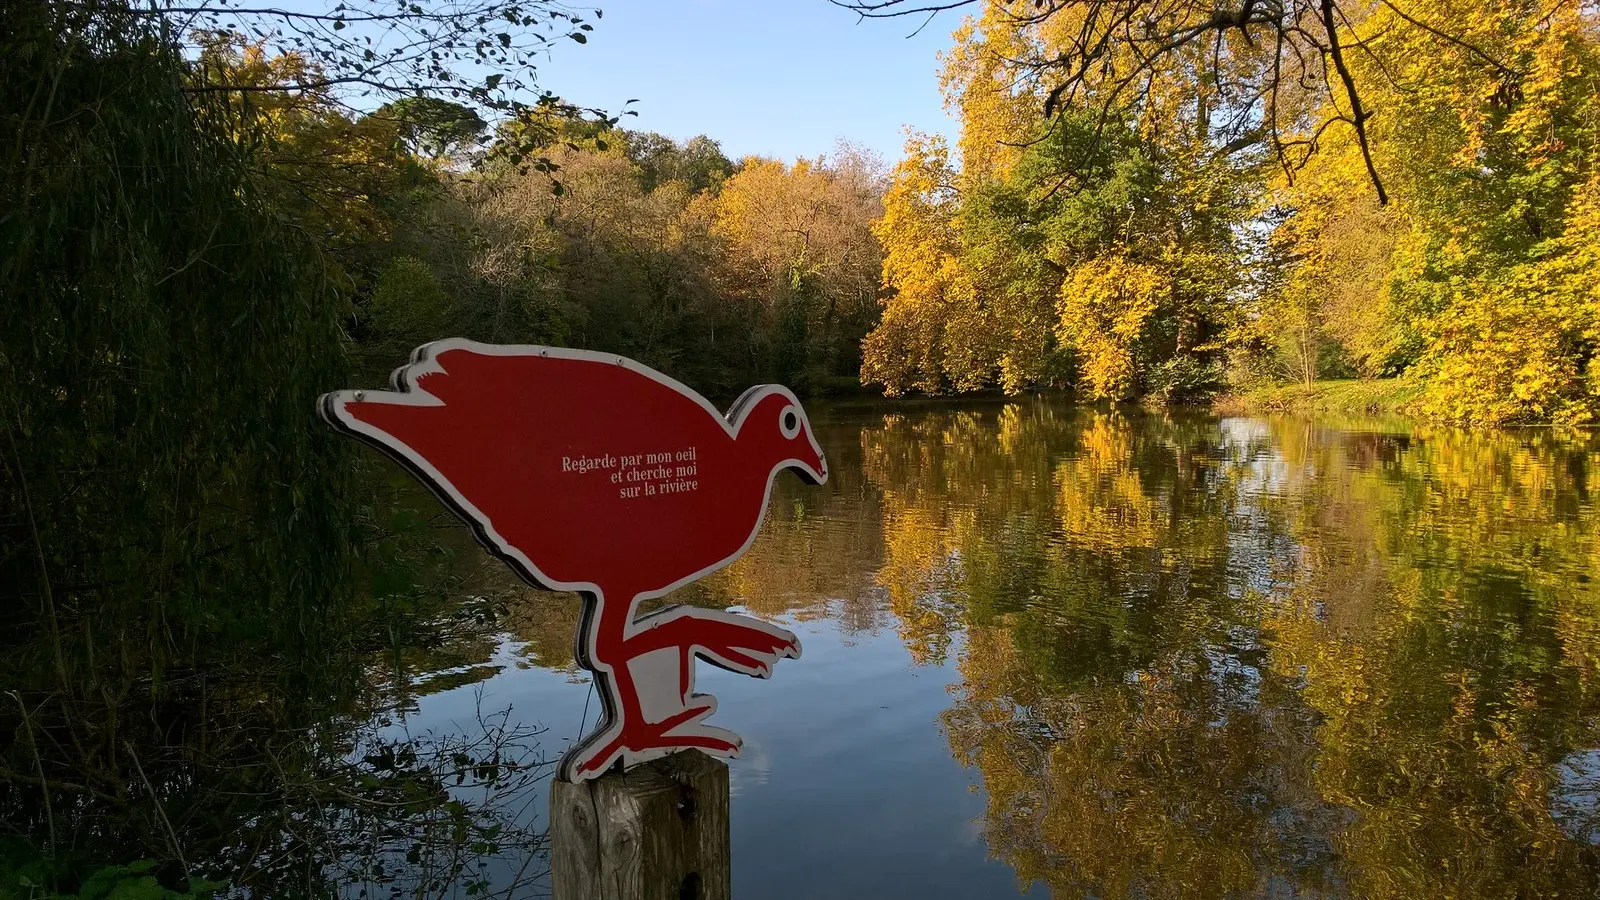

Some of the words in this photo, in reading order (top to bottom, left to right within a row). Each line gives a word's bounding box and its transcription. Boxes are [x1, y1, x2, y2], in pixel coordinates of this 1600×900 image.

[562, 453, 617, 474] Regarde
[620, 454, 643, 470] par
[646, 451, 672, 464] mon
[675, 446, 697, 461] oeil
[611, 471, 623, 484] et
[626, 465, 673, 482] cherche
[676, 462, 697, 477] moi
[620, 486, 641, 499] sur
[644, 481, 656, 496] la
[659, 478, 698, 494] rivière
